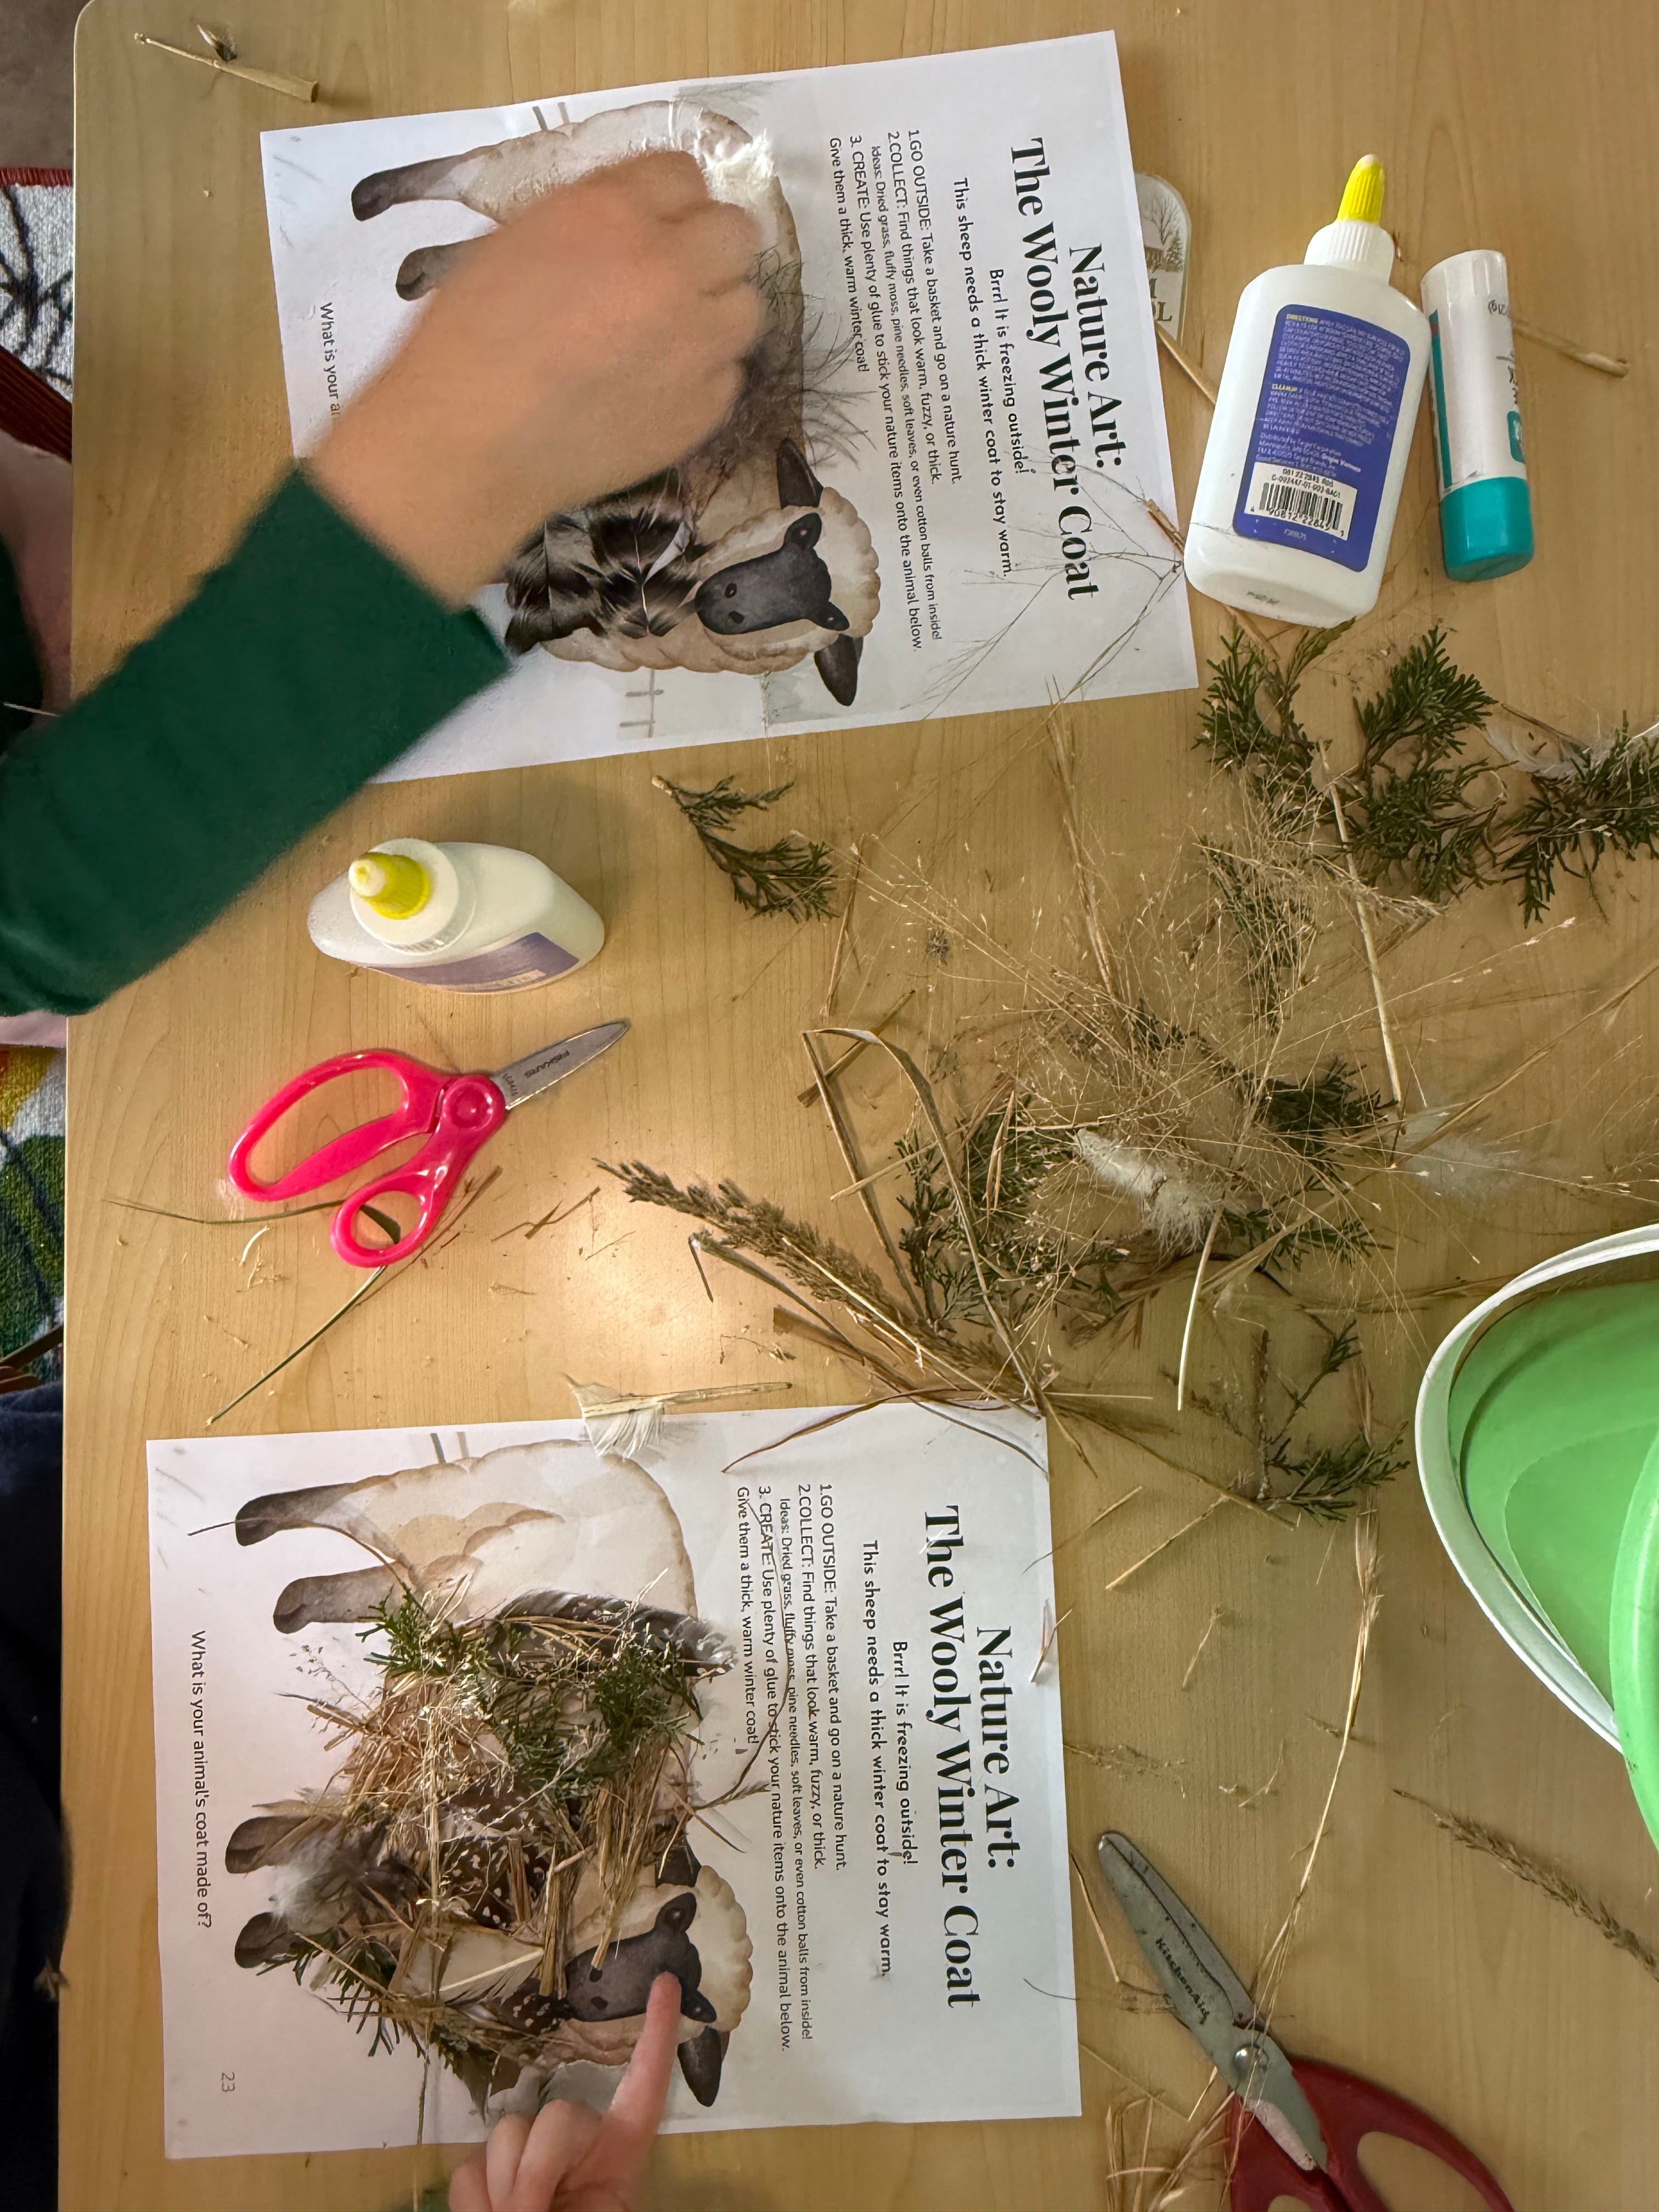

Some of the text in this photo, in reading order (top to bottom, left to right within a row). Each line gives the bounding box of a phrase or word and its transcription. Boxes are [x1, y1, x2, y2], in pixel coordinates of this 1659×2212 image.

[830, 137, 842, 167] Give
[833, 170, 845, 204] them
[913, 165, 932, 231] OUTSIDE:
[838, 207, 847, 215] a
[898, 211, 912, 240] Find
[901, 243, 915, 284] things
[921, 232, 935, 264] Take
[844, 255, 857, 293] warm
[925, 268, 934, 276] a
[907, 286, 921, 315] that
[927, 279, 943, 323] basket
[319, 302, 335, 347] What
[910, 317, 926, 346] look
[933, 325, 947, 351] and
[325, 349, 337, 363] is
[915, 348, 927, 390] warm,
[934, 353, 947, 370] go
[989, 269, 1030, 474] Brrr! It is freezing outside!
[1011, 137, 1099, 600] The Wooly Winter Coat
[1069, 244, 1127, 469] Nature Art:
[323, 364, 338, 400] your
[850, 135, 922, 652] 3. CREATE: Use plenty of glue to stick your nature items onto the animal below.
[939, 374, 949, 391] on
[953, 177, 1013, 577] This sheep needs a thick winter coat to stay warm.
[921, 392, 933, 430] fuzzy,
[941, 394, 950, 402] a
[925, 432, 935, 446] or
[943, 405, 956, 448] nature
[928, 449, 943, 485] thick.
[948, 450, 962, 484] hunt.
[524, 1049, 570, 1079] FISKARS
[821, 1522, 837, 1593] OUTSIDE:
[802, 1572, 816, 1602] Find
[737, 1486, 761, 1745] Give them a thick, warm winter coat!
[802, 1606, 816, 1651] things
[825, 1596, 838, 1630] Take
[826, 1633, 836, 1643] a
[805, 1654, 819, 1684] that
[826, 1646, 840, 1694] basket
[806, 1687, 820, 1717] look
[828, 1697, 842, 1724] and
[808, 1721, 819, 1765] warm,
[829, 1728, 840, 1746] go
[893, 1641, 918, 1865] Brrr! It is freezing outside!
[977, 1626, 1020, 1869] Nature Art:
[758, 1486, 793, 2051] 3. CREATE: Use plenty of glue to stick your nature items onto the animal below.
[780, 1498, 813, 2039] Ideas: Dried pine needles, soft leaves, or even cotton balls from inside!
[831, 1750, 841, 1768] on
[863, 1539, 891, 1977] This sheep needs a thick winter coat to stay warm.
[924, 1505, 981, 2009] The Wooly Winter Coat
[190, 1630, 212, 1928] What is your animal's coat made of?
[809, 1769, 823, 1809] fuzzy,
[832, 1771, 842, 1780] a
[812, 1813, 822, 1828] or
[833, 1784, 845, 1831] nature
[813, 1832, 826, 1869] thick.
[835, 1834, 848, 1871] hunt.
[221, 2072, 235, 2092] 23
